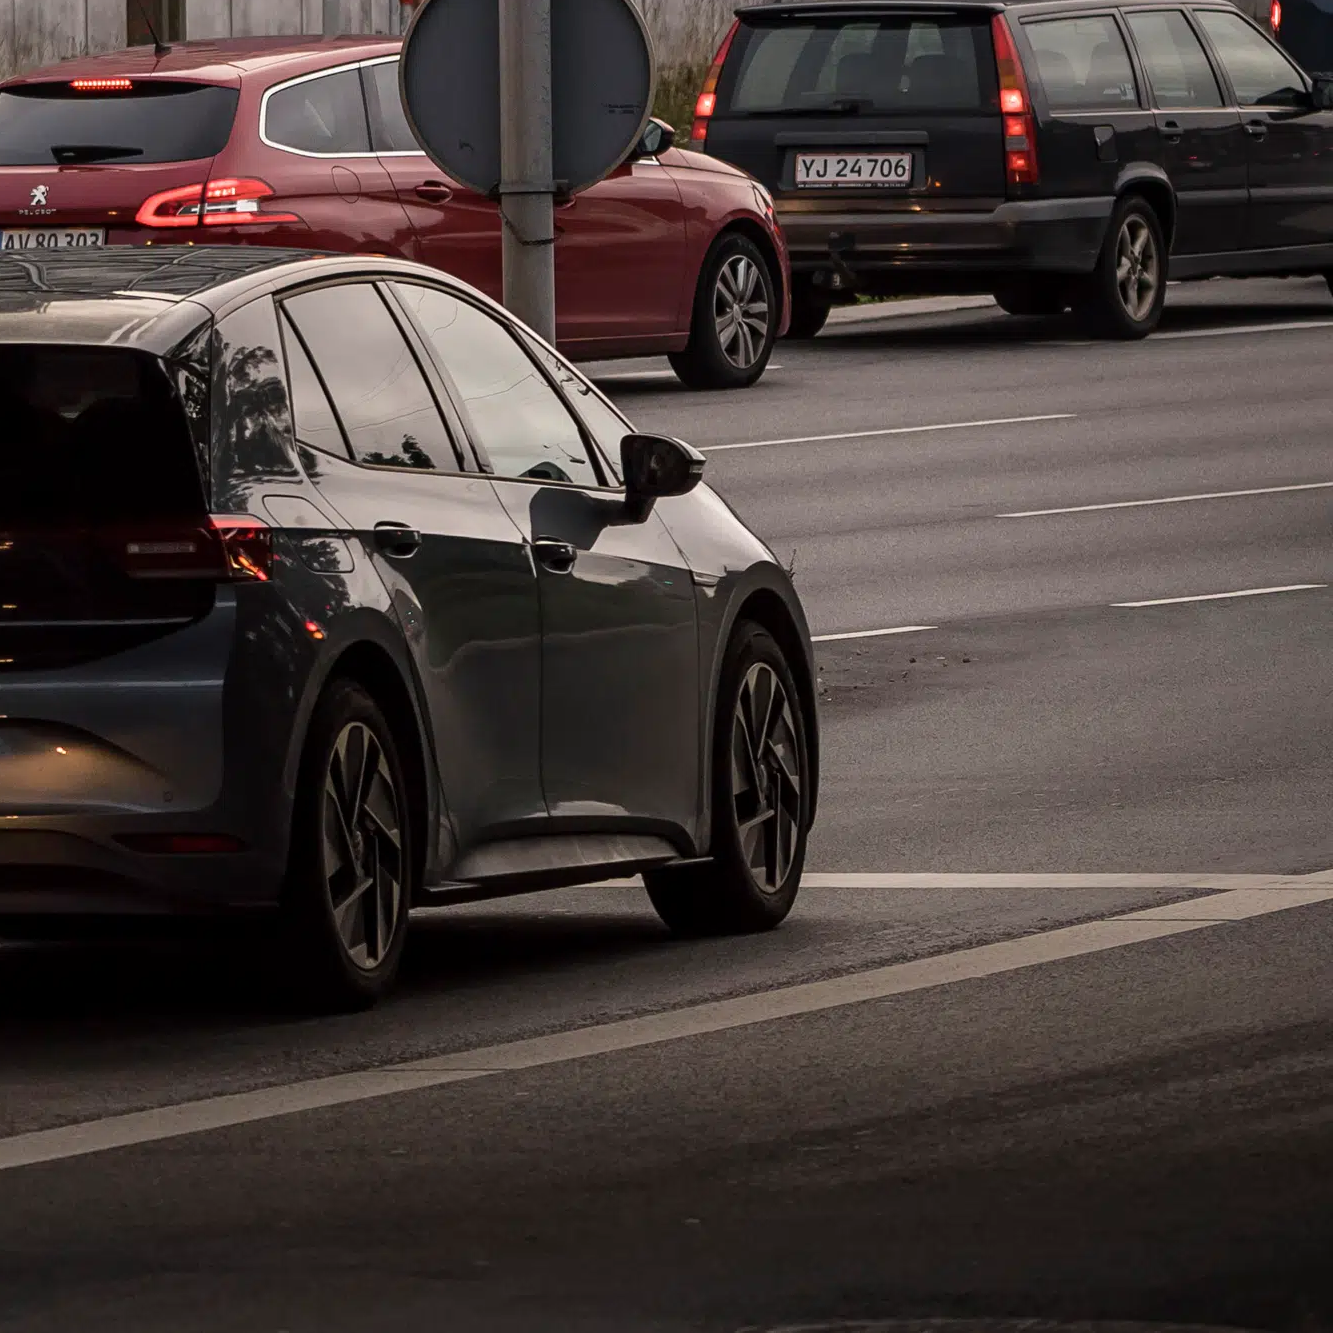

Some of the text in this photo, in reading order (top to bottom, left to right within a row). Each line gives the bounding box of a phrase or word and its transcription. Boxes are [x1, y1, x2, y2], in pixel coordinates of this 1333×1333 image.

[802, 158, 907, 178] YJ 24 706
[5, 233, 100, 250] AV 80 303
